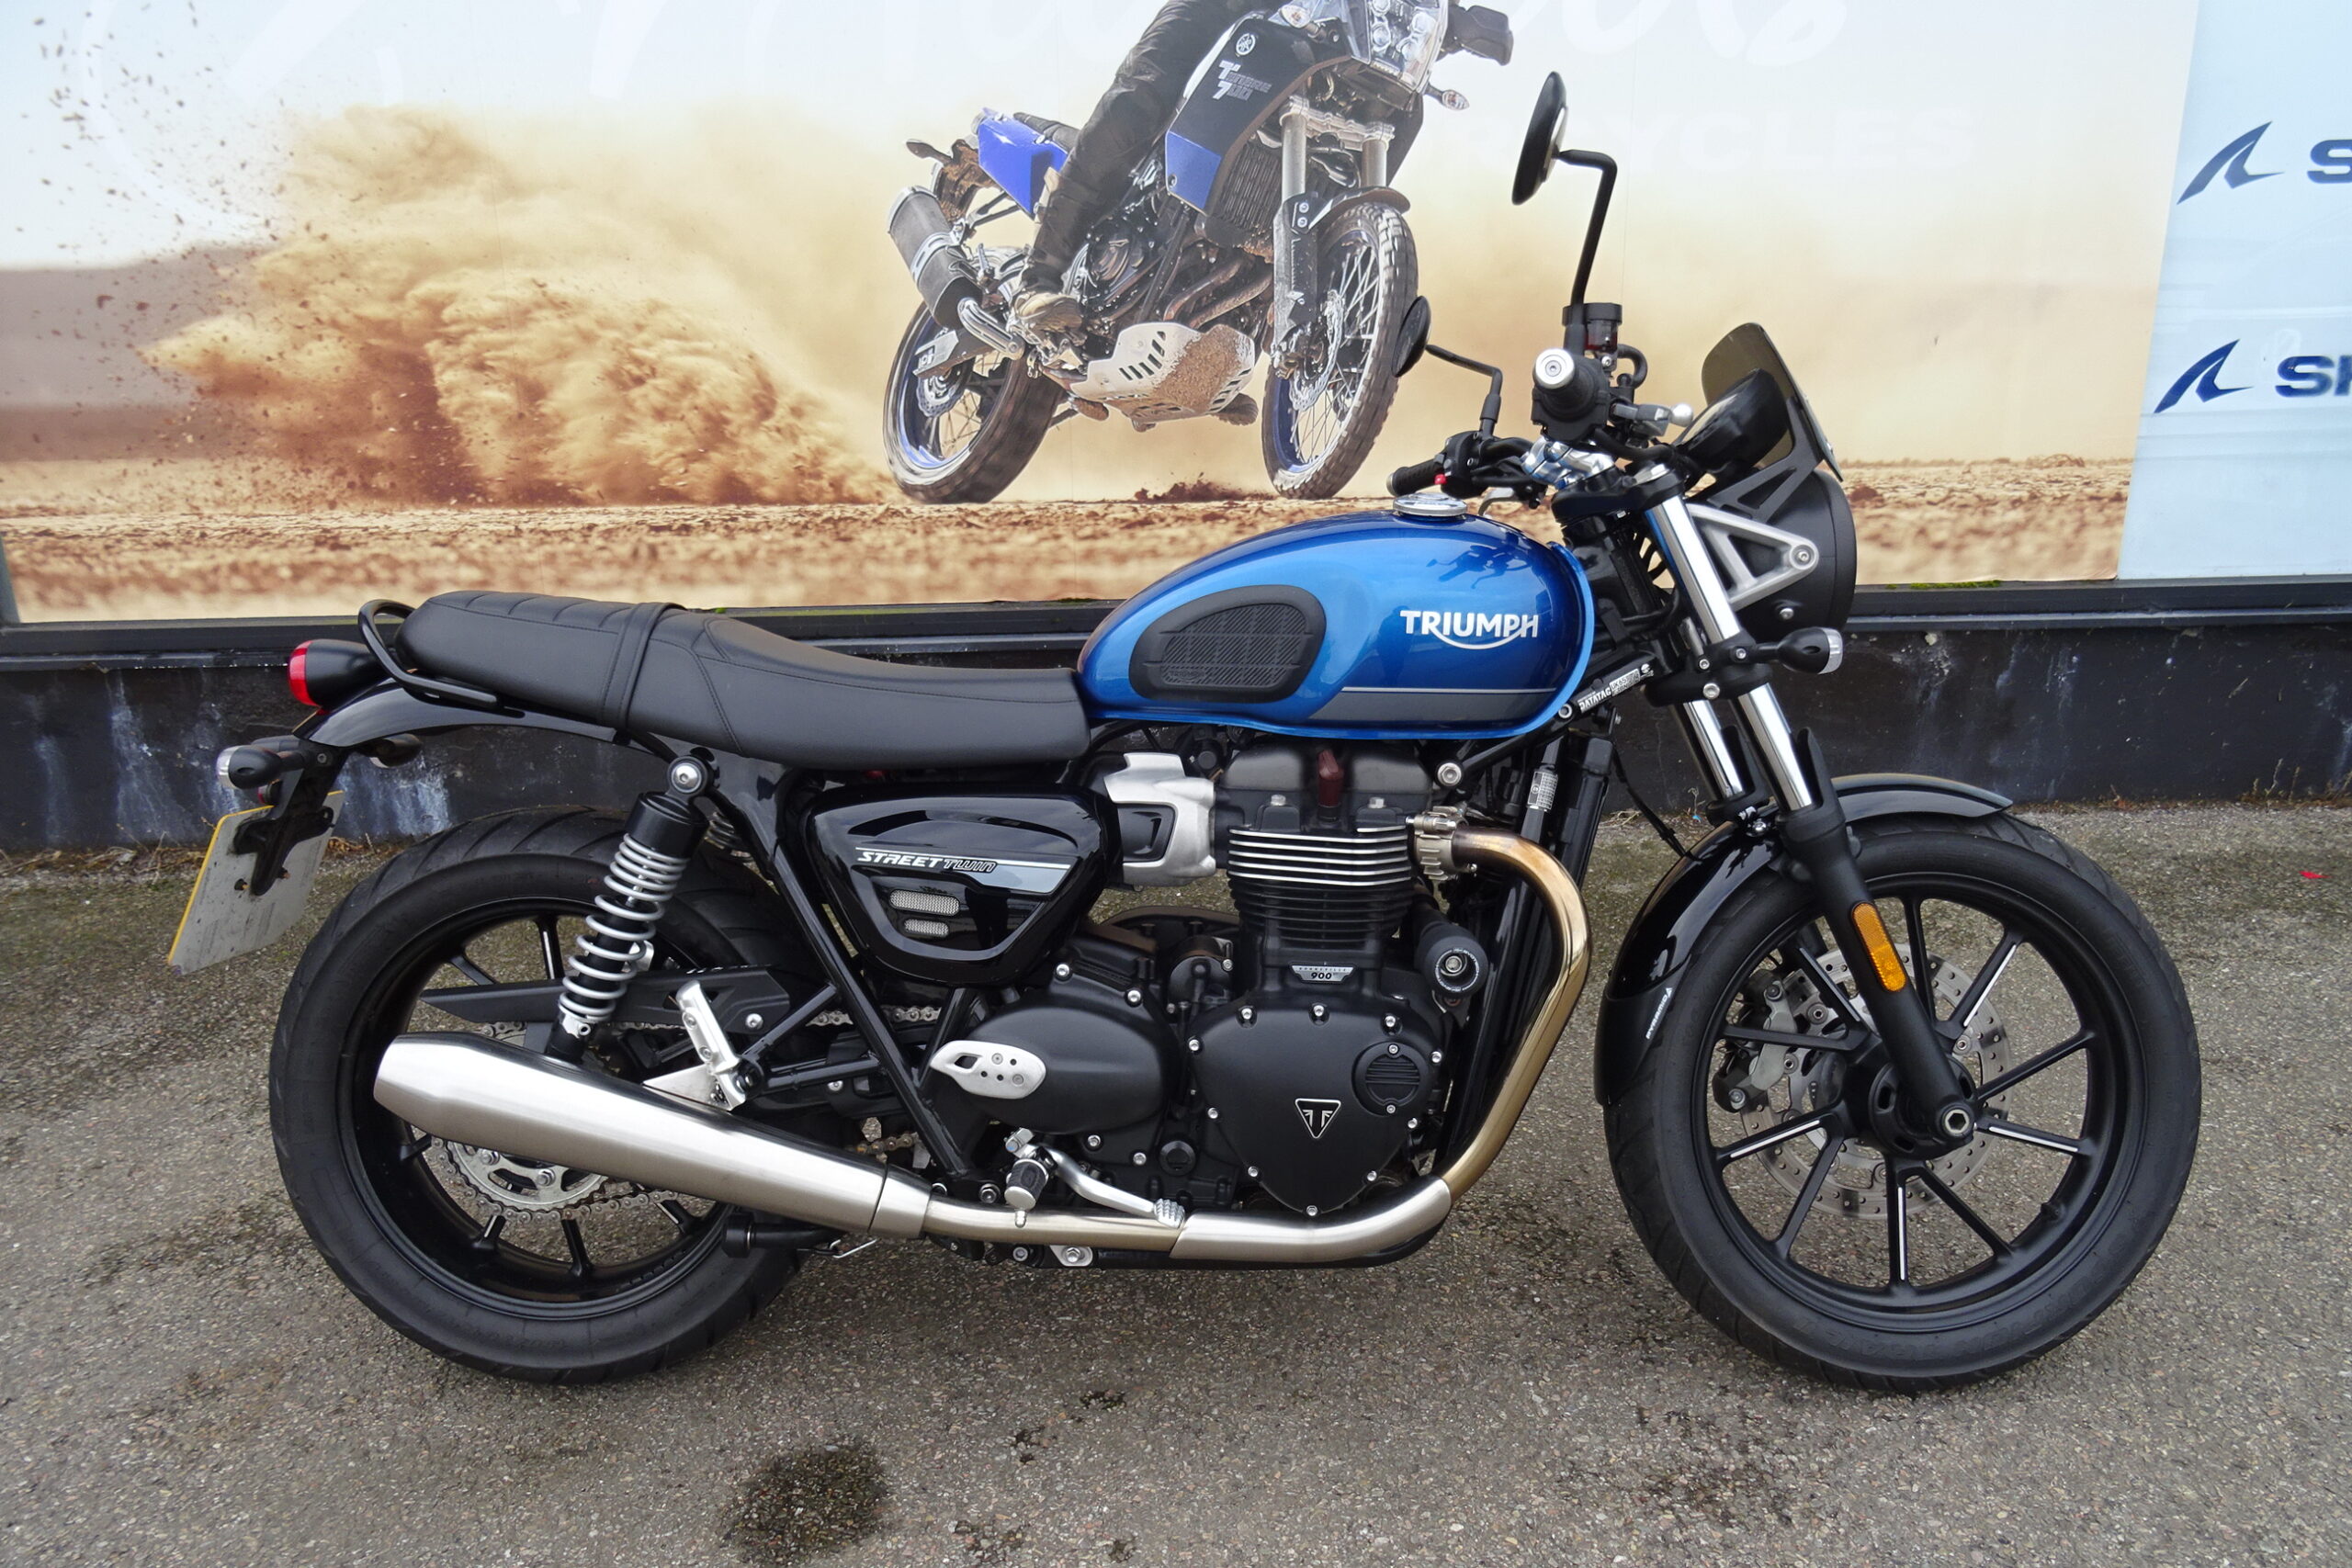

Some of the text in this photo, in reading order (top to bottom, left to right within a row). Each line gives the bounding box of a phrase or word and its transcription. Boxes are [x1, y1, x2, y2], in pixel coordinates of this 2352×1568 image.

[1399, 610, 1539, 649] TRIUMPH
[1578, 687, 1611, 713] DATATAG
[857, 851, 944, 868] STREET
[1311, 972, 1332, 980] 900
